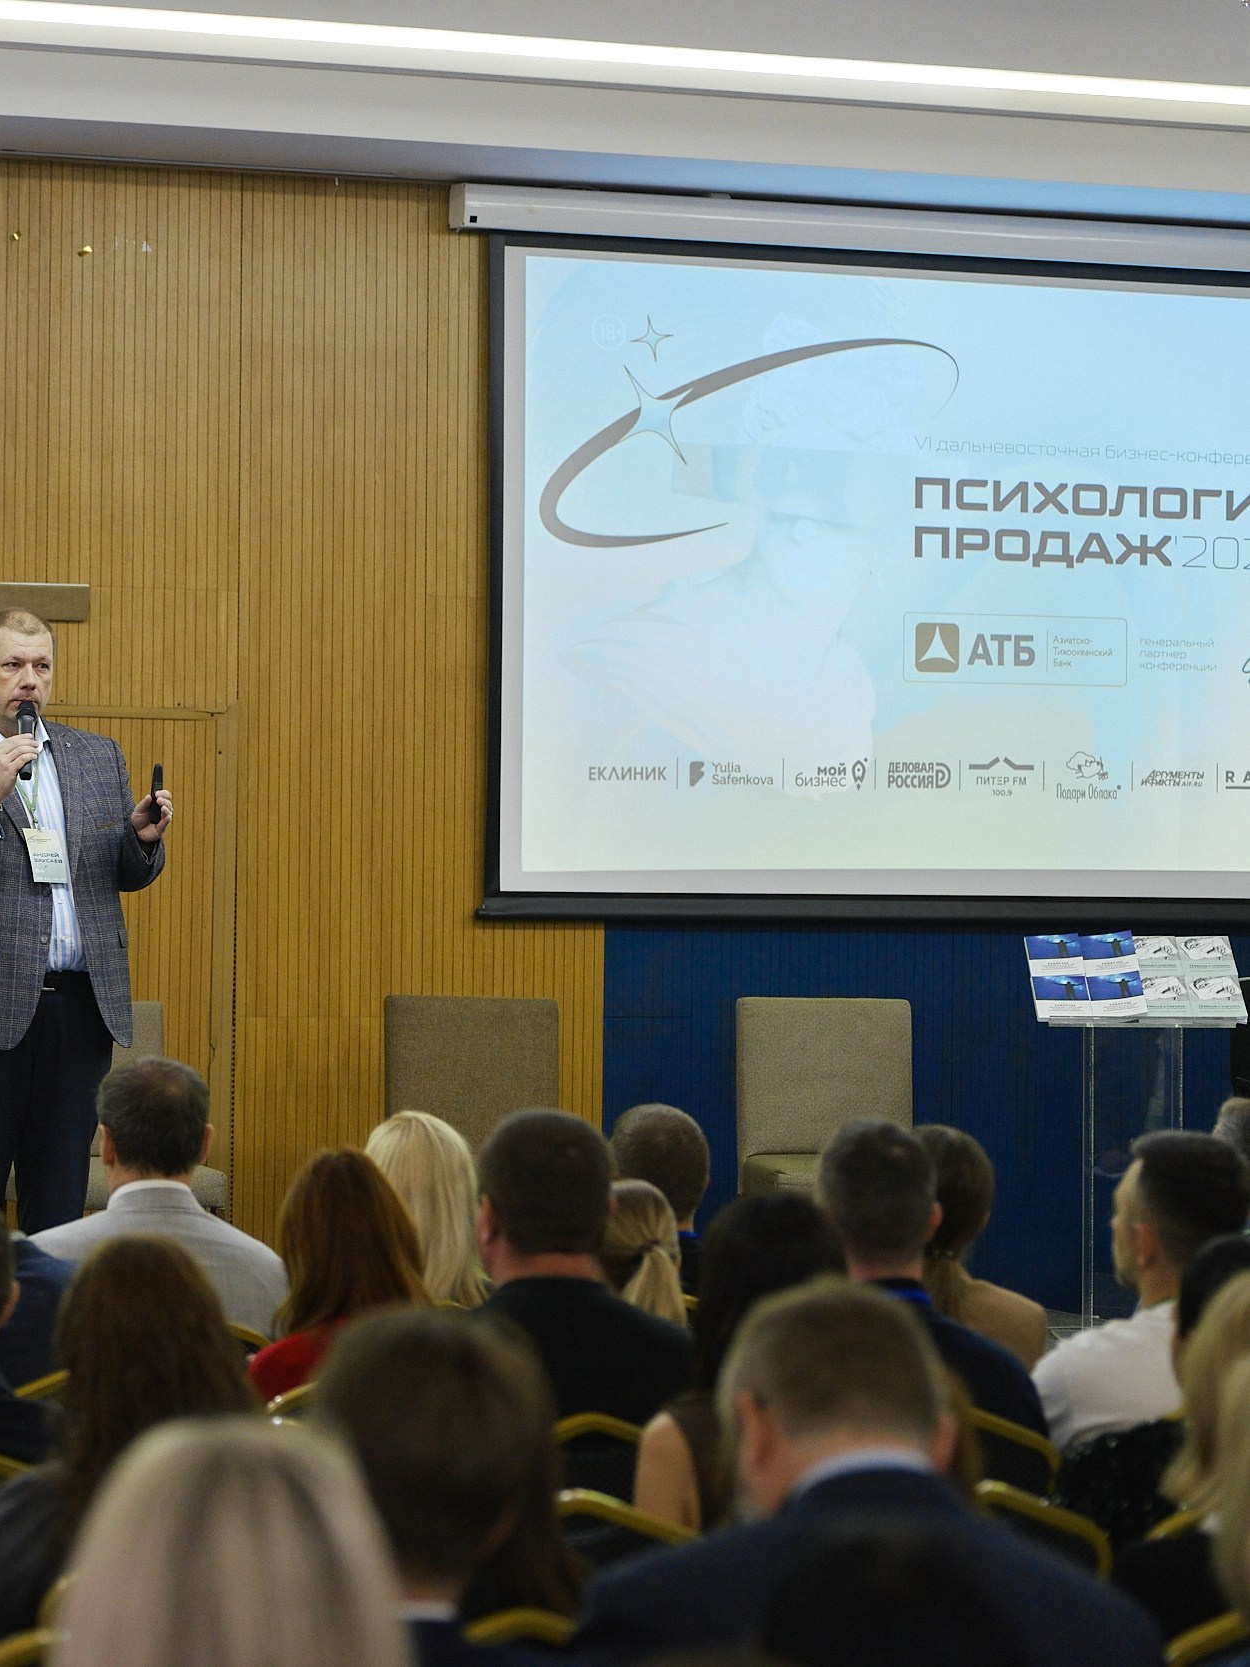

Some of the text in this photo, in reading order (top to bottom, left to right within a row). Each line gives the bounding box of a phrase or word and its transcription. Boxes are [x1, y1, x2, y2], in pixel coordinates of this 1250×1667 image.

[936, 439, 1100, 458] дальневосточная
[1139, 637, 1215, 648] генеральный
[967, 633, 1036, 667] АТБ
[1053, 647, 1113, 657] Тихоокеанский
[1139, 650, 1187, 660] партнер
[1053, 658, 1072, 667] Банк
[1139, 662, 1218, 672] конференции
[712, 762, 742, 774] Yulia
[817, 763, 847, 777] мой
[888, 762, 934, 774] ДЕЛОВАЯ
[712, 774, 774, 786] Safenkova
[795, 772, 847, 788] бизнес
[887, 774, 934, 789] РОССИЯ
[1013, 777, 1027, 786] FM
[992, 789, 1012, 797] 100.9
[1056, 783, 1118, 802] Подари Облака
